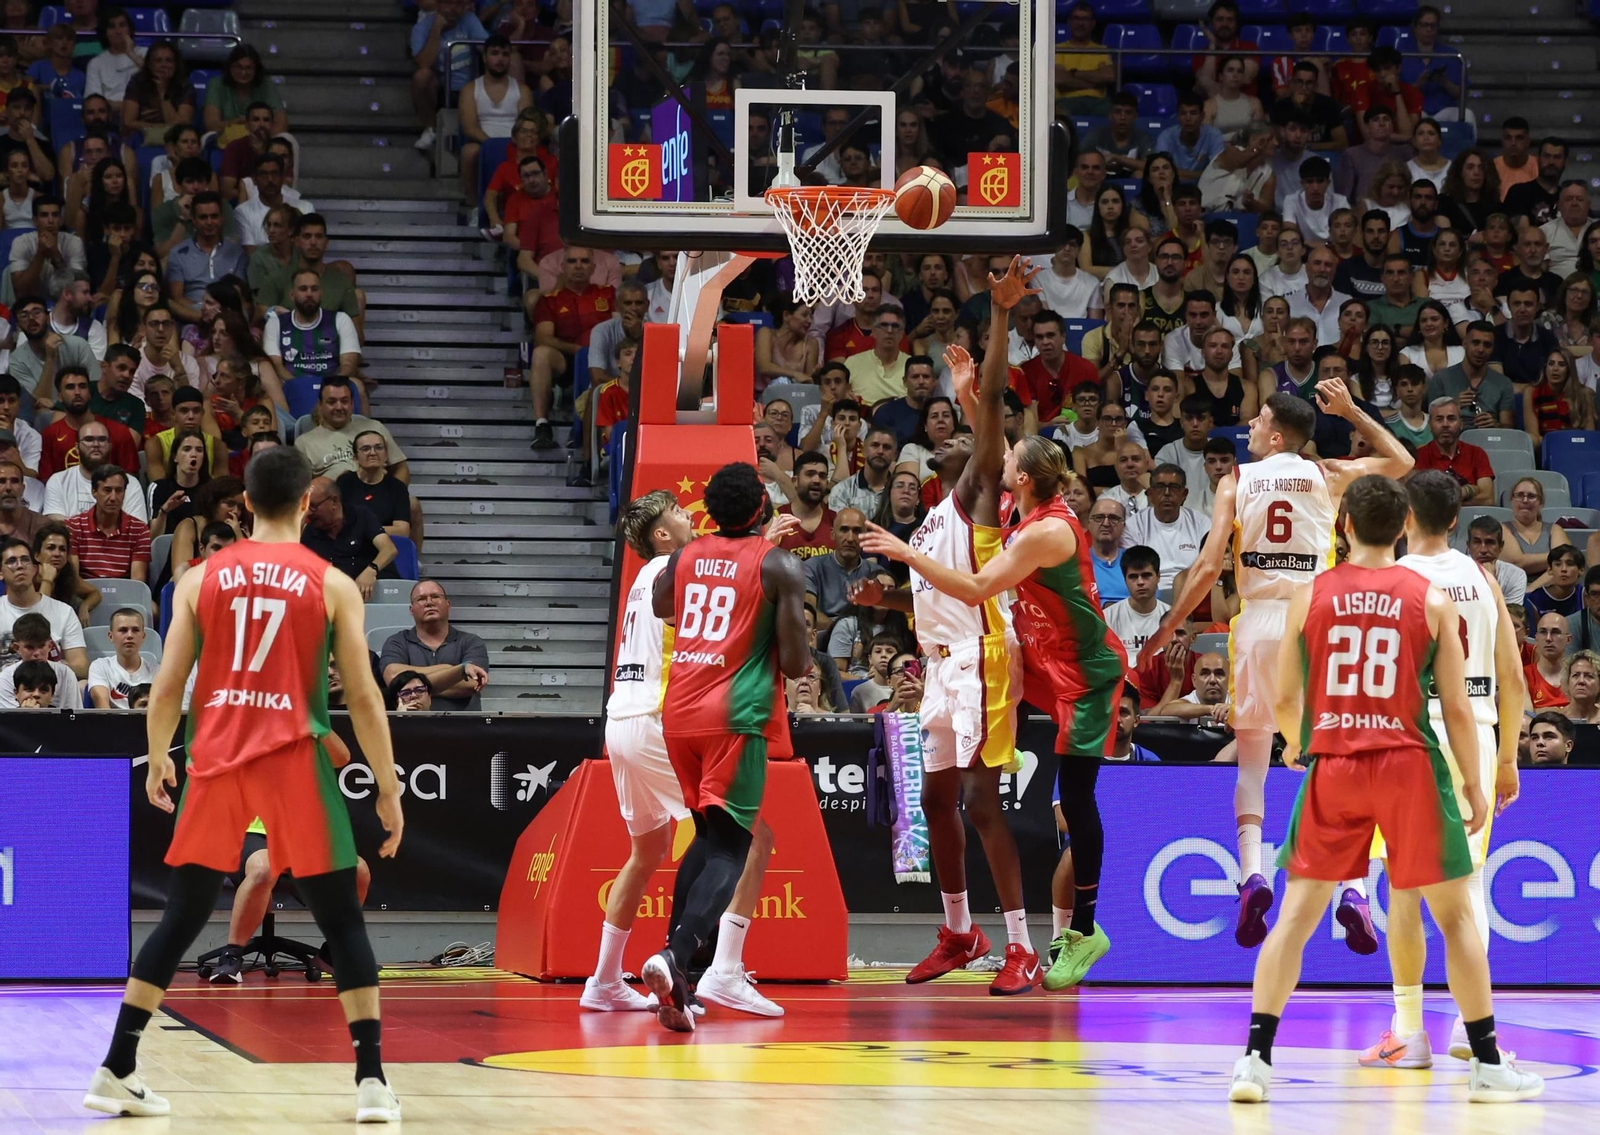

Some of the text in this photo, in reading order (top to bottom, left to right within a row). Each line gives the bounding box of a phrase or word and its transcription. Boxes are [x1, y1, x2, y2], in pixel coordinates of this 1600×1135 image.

[661, 104, 689, 202] enfe
[1265, 500, 1293, 544] 6
[217, 561, 308, 598] DA SILVA
[695, 558, 738, 580] QUETA
[1256, 554, 1314, 570] CaixaBank
[678, 582, 736, 642] 88
[1332, 591, 1402, 621] LISBOA
[230, 596, 287, 673] 17
[677, 651, 726, 668] DHIKA
[1326, 625, 1401, 699] 28
[227, 688, 293, 711] DHIKA
[1341, 712, 1405, 732] DHIKA
[901, 750, 925, 819] VERDE
